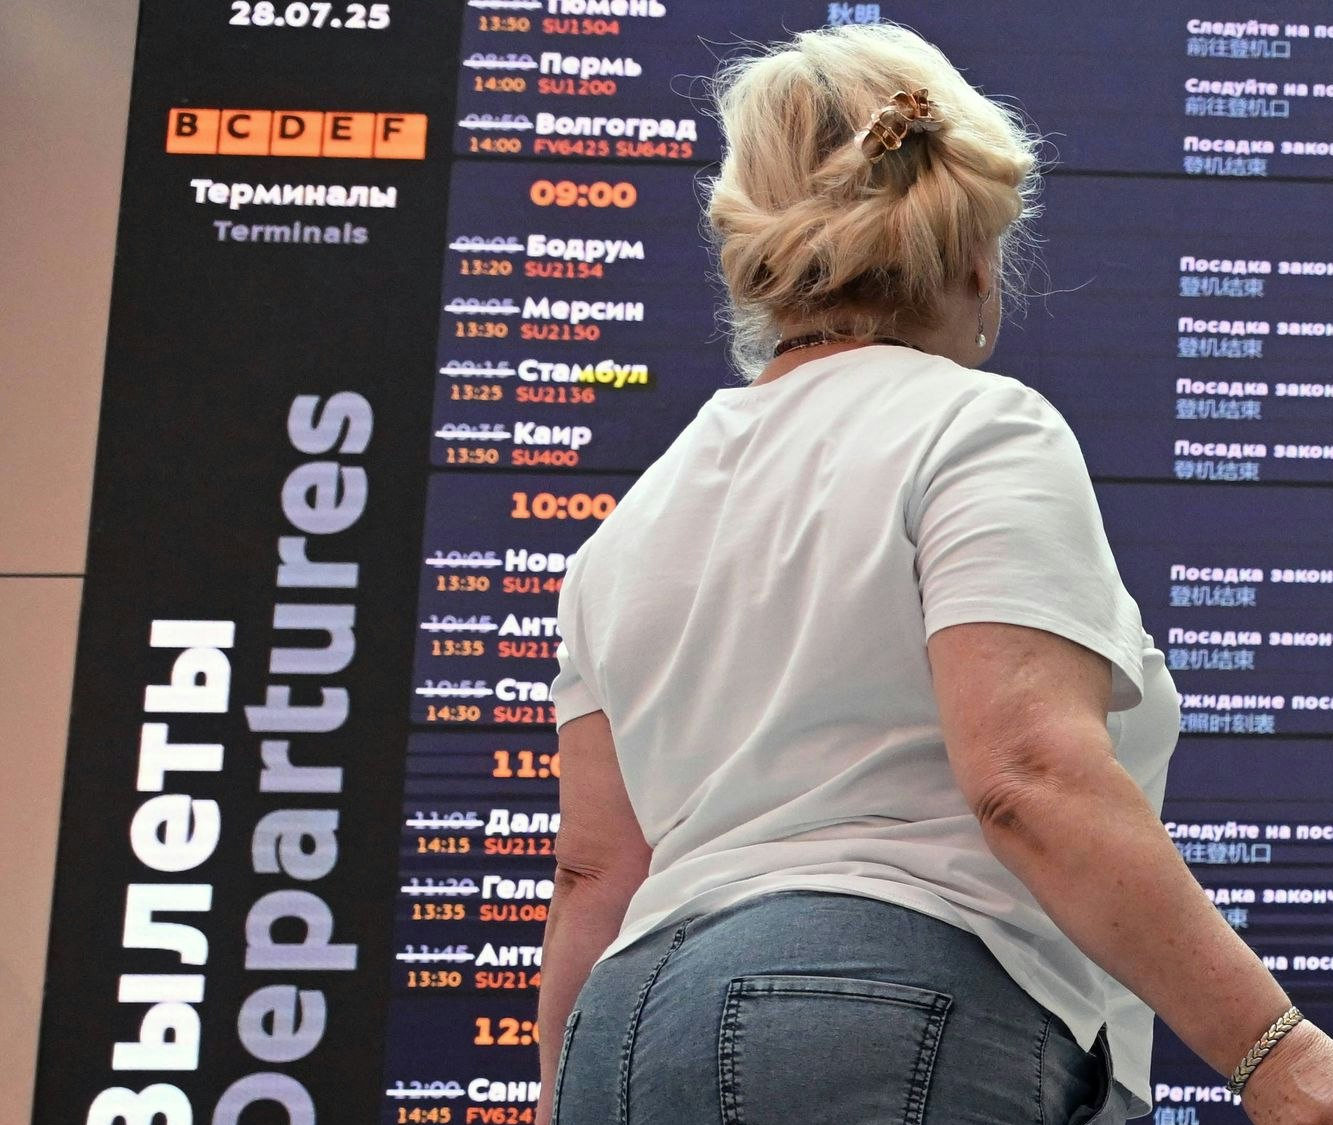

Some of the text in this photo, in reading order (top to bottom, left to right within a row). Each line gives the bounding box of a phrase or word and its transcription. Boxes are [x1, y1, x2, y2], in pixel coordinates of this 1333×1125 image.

[229, 1, 390, 29] 28.07.25
[540, 52, 642, 80] Пермь
[538, 76, 616, 95] SU1200
[176, 114, 401, 142] B C D E F
[536, 113, 697, 141] Волгоград
[534, 138, 692, 158] FV6425 SU6425
[1184, 136, 1274, 155] Посадка
[191, 179, 397, 210] Терминалы
[530, 180, 636, 208] 09:00
[214, 221, 367, 244] Terminals
[527, 235, 644, 263] Бодрум
[525, 261, 603, 278] SU2154
[522, 297, 644, 324] Мерсин
[518, 359, 648, 387] Стамбул
[514, 422, 592, 450] Каир
[512, 447, 579, 466] SU400
[398, 1107, 451, 1123] 14:45
